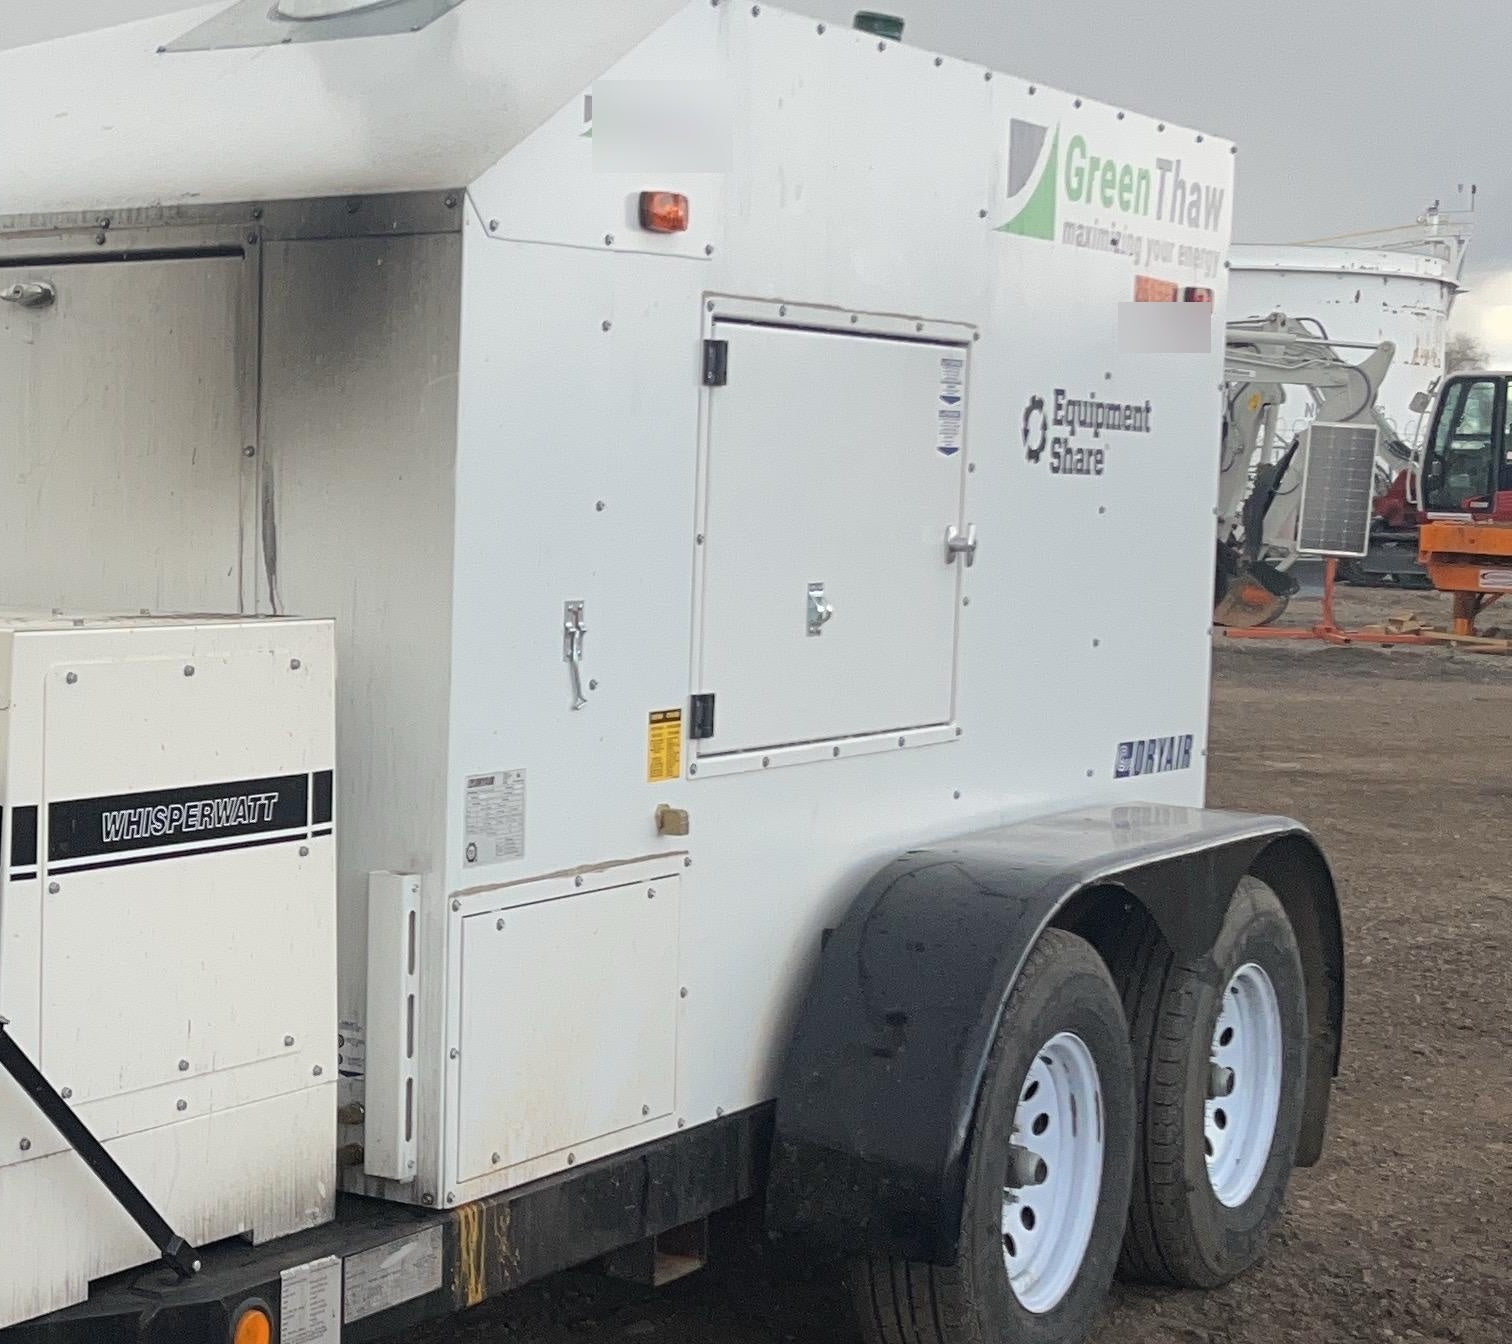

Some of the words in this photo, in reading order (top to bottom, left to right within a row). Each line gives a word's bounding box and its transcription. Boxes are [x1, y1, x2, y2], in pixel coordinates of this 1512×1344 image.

[1061, 217, 1144, 267] maximizing
[1147, 236, 1176, 268] your
[1177, 243, 1221, 279] energy
[1052, 387, 1152, 439] Equipment
[1049, 436, 1105, 476] Share
[1126, 734, 1194, 777] DRYAIR
[101, 791, 280, 843] WHISPERWATT
